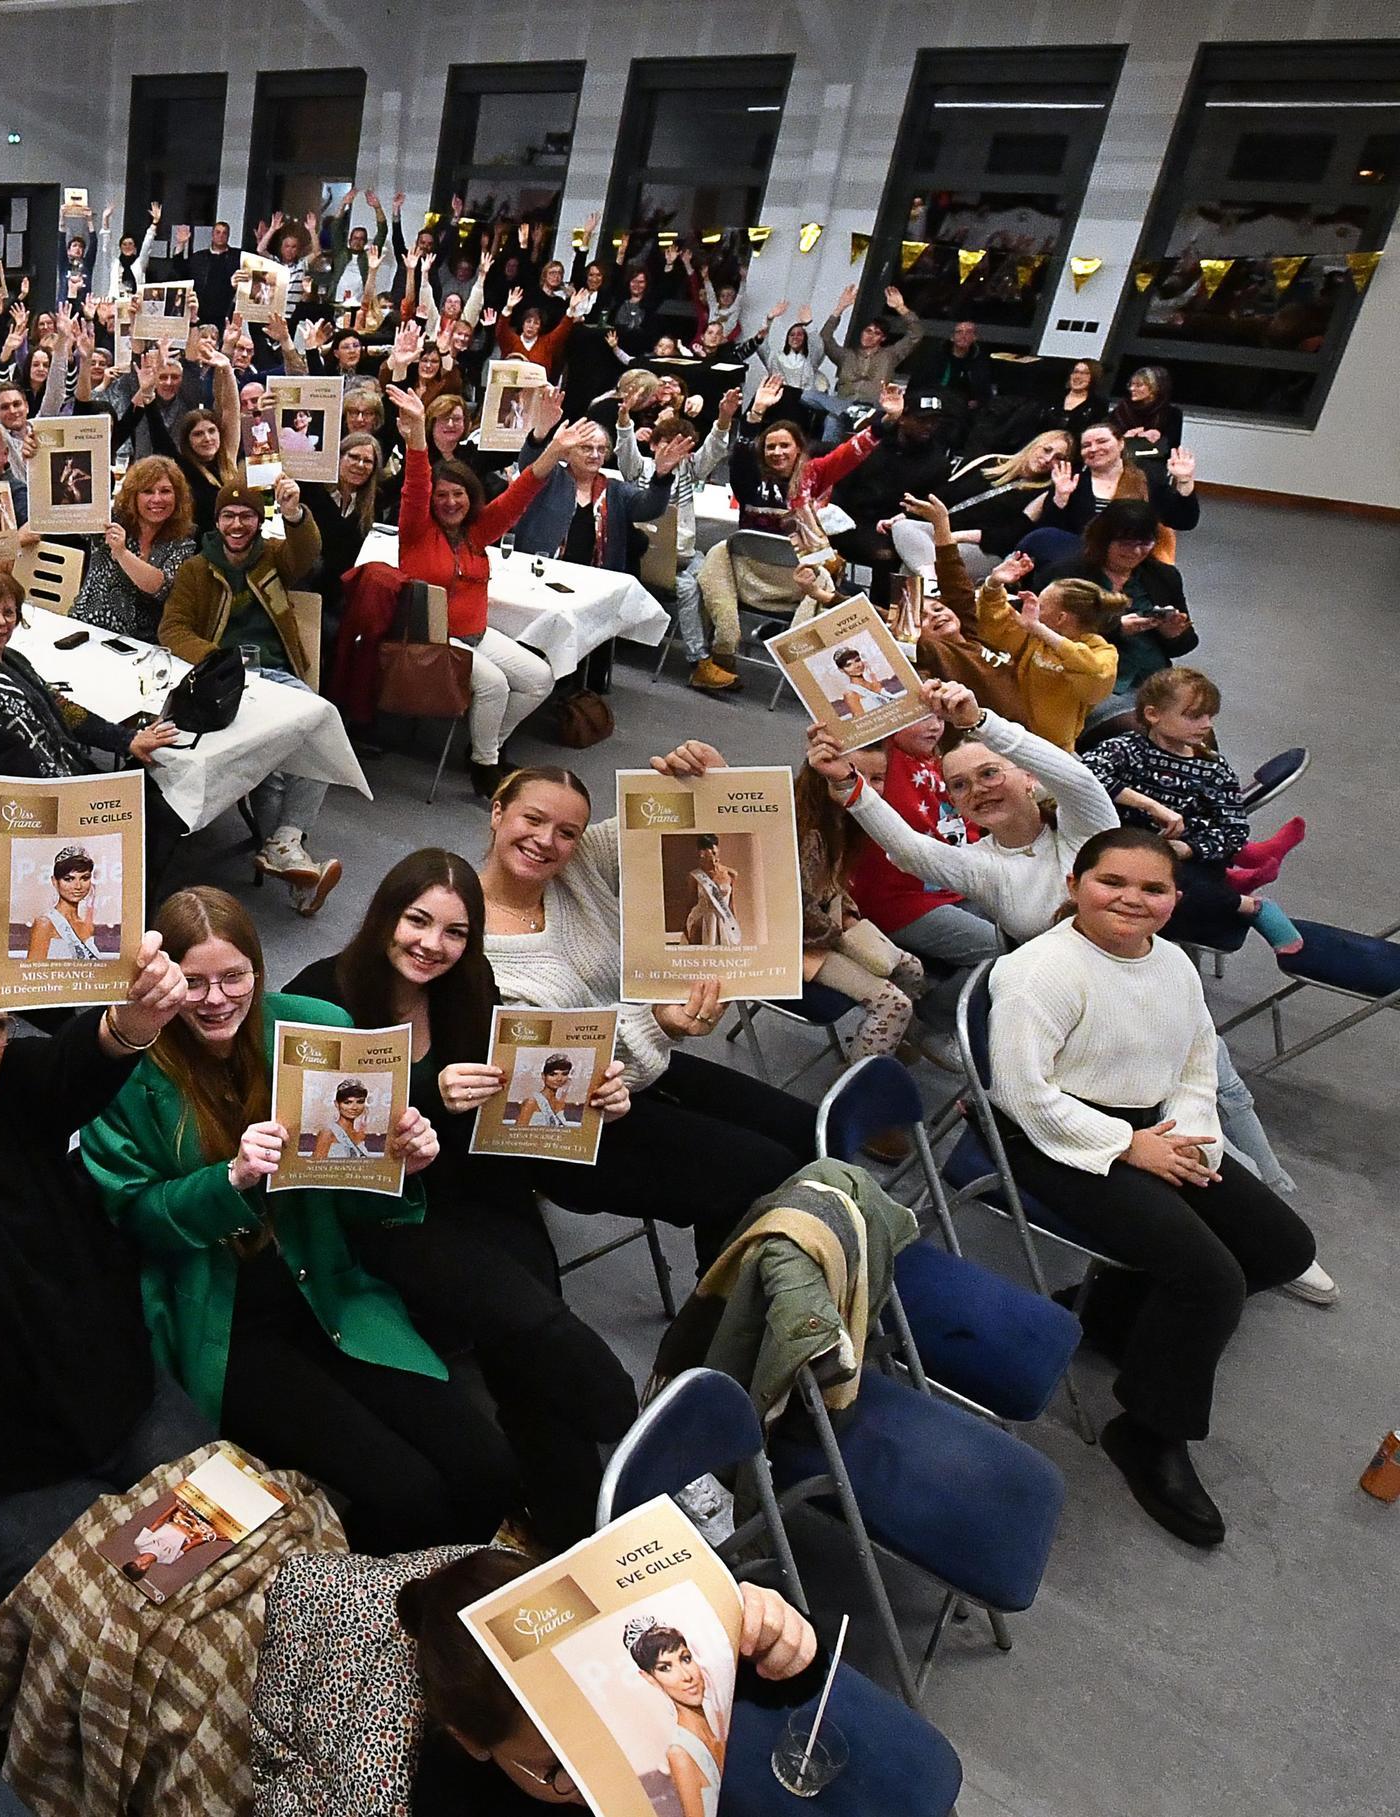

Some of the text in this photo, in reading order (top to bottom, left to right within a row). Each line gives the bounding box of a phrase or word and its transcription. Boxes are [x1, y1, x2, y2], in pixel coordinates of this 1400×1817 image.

[727, 792, 764, 801] VOTEZ
[89, 800, 121, 810] VOTEZ
[717, 803, 779, 814] EVE GILLES
[80, 812, 133, 825] EVE GILLES
[672, 958, 751, 968] MISS FRANCE
[22, 970, 95, 981] MISS FRANCE
[367, 1047, 393, 1055] VOTEZ
[376, 1055, 401, 1065] GILLES
[615, 1540, 664, 1568] VOTEZ
[616, 1548, 692, 1590] EVE GILLES
[534, 1610, 575, 1644] france
